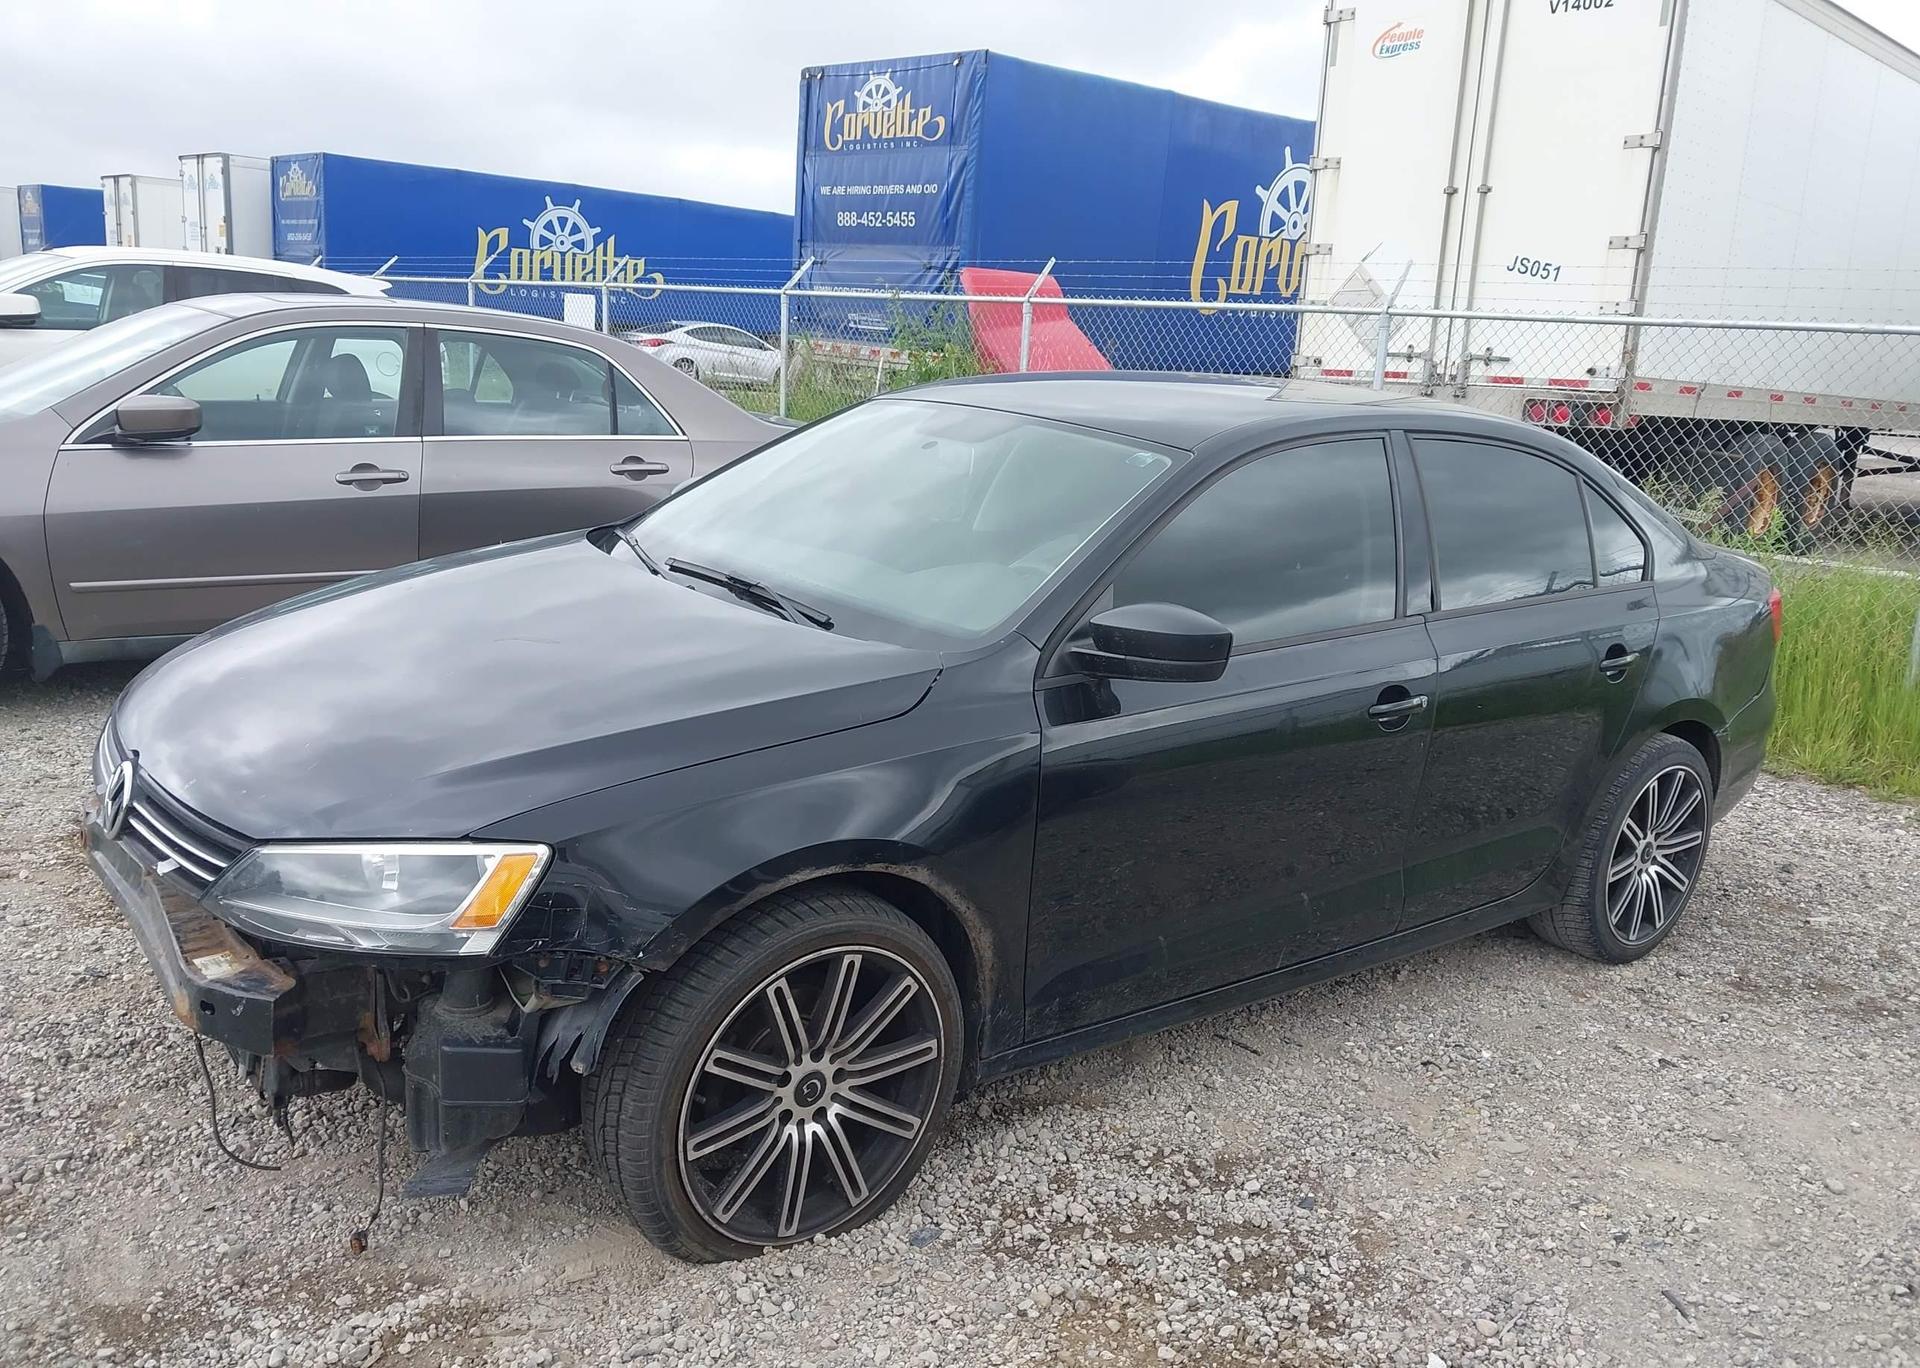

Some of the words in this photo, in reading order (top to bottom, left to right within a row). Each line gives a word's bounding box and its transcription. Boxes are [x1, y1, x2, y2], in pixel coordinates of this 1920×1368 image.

[1382, 28, 1424, 44] People
[1379, 40, 1421, 55] Express
[824, 90, 946, 151] Corvette
[843, 142, 895, 151] LOGISTICS
[820, 186, 832, 195] WE
[832, 186, 846, 195] ARE
[847, 185, 871, 195] HIRING
[873, 184, 905, 195] DRIVERS
[906, 184, 923, 194] AND
[837, 211, 916, 227] 888-452-5455
[474, 226, 664, 300] Corvette
[1190, 198, 1306, 315] Corv
[1507, 255, 1562, 282] JS051
